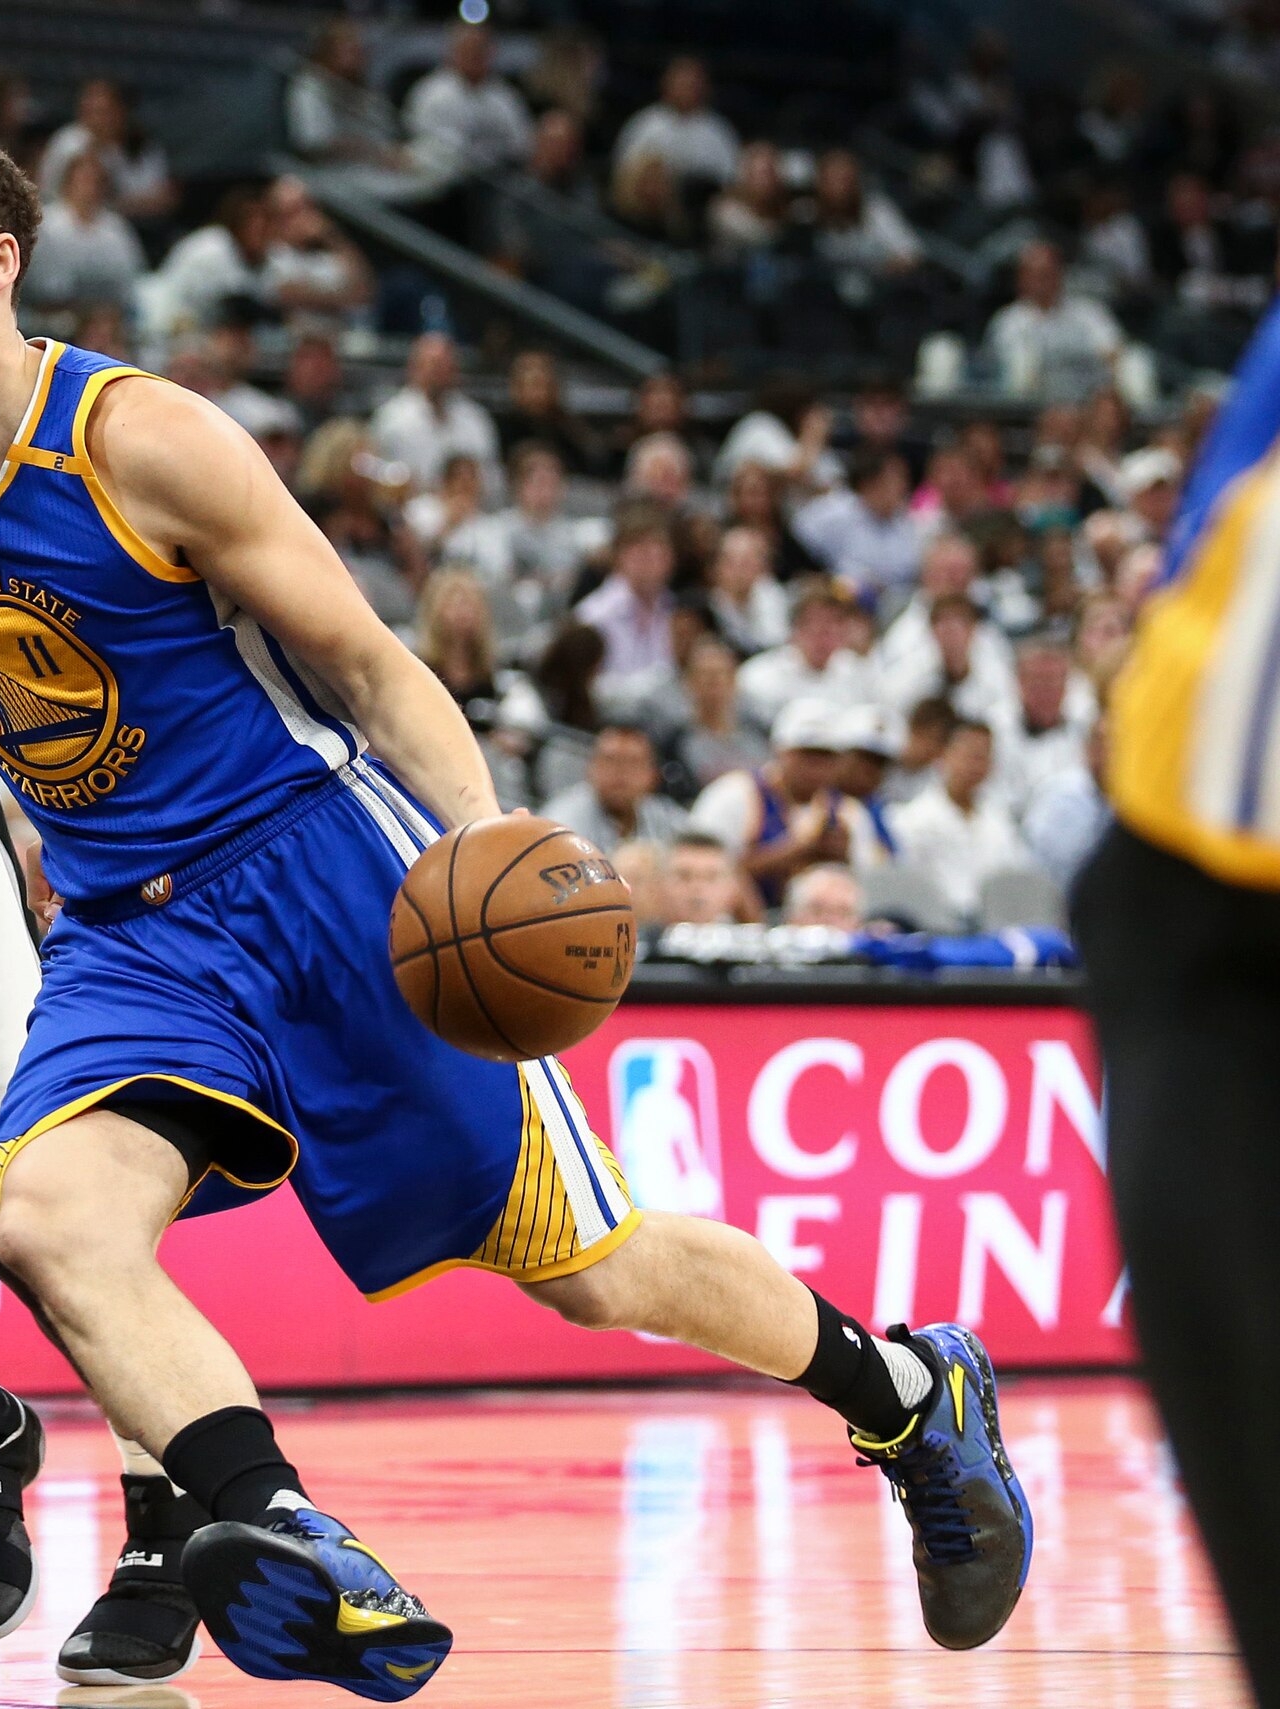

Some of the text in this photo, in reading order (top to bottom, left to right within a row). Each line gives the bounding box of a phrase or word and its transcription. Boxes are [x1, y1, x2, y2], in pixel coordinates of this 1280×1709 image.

[54, 455, 65, 470] 2
[8, 577, 83, 629] STATE
[16, 633, 63, 679] 11
[756, 1189, 1131, 1331] FIN
